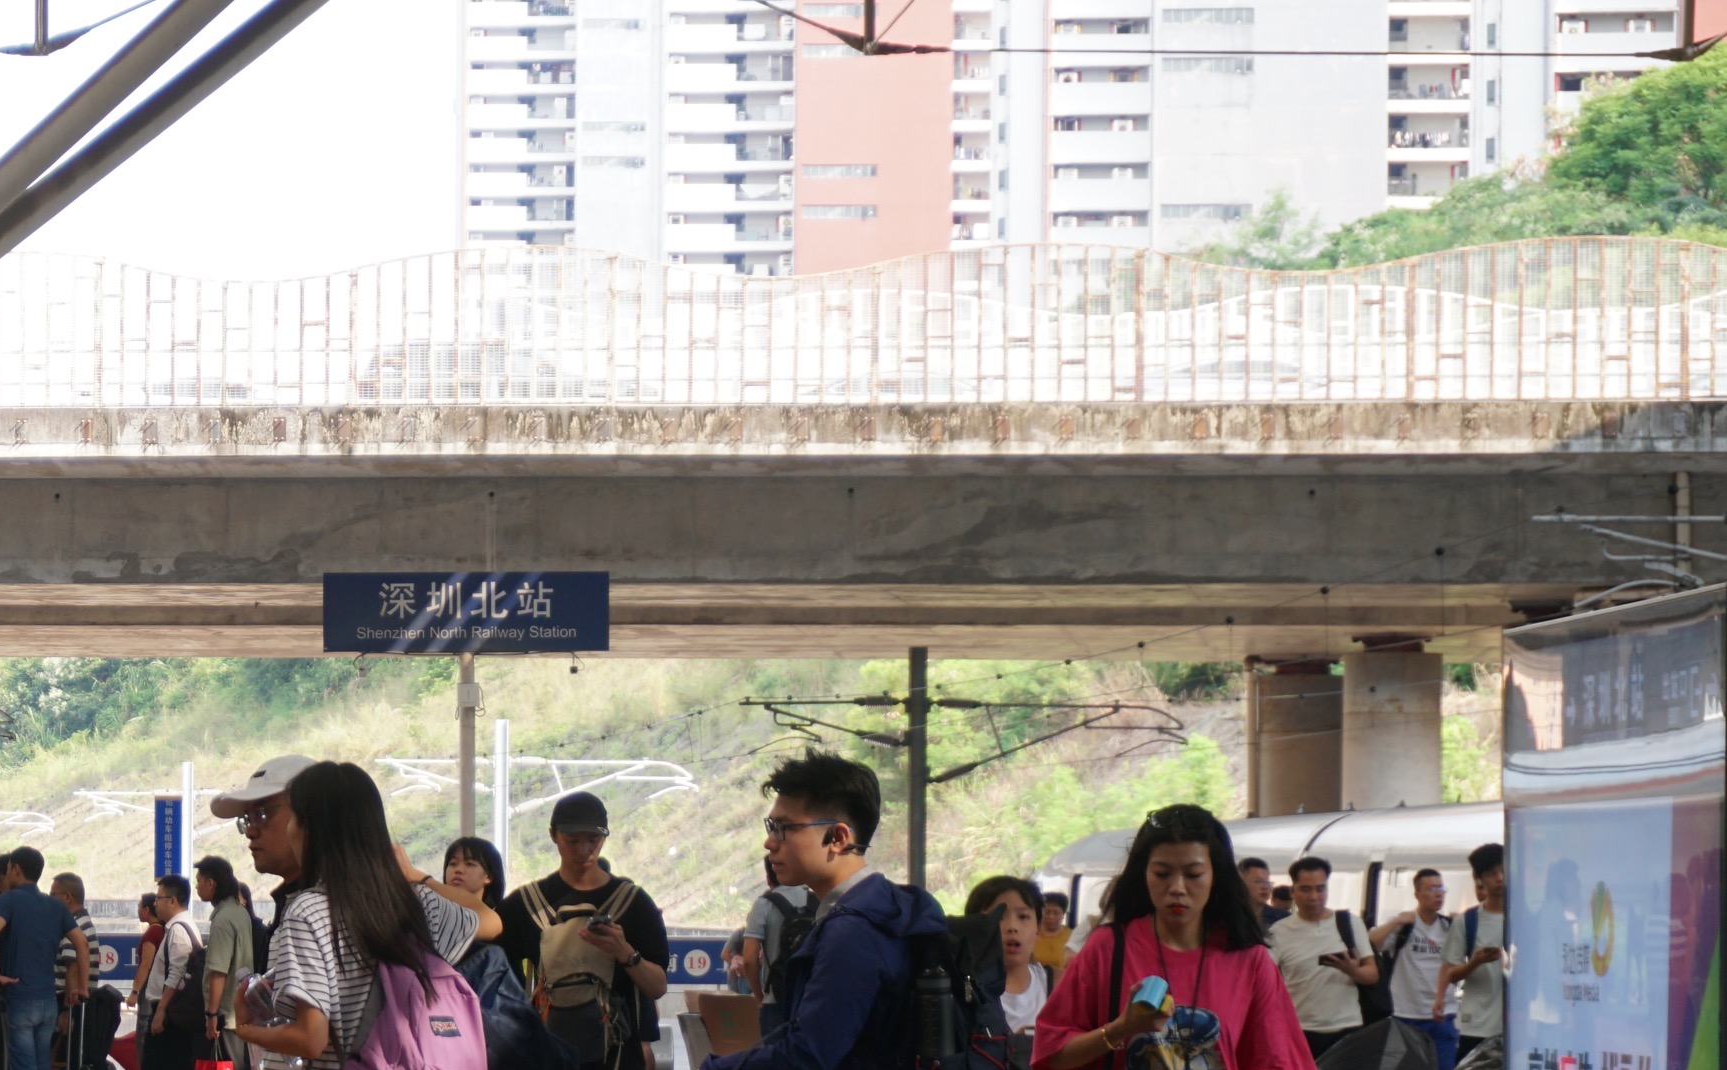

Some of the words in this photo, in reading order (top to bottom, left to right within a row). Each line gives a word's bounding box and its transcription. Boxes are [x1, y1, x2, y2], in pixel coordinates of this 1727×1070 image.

[379, 582, 553, 619] 深圳北站
[357, 627, 424, 639] Shenzhen
[430, 627, 466, 639] North
[472, 626, 524, 641] Railway
[529, 626, 576, 638] Station
[688, 955, 707, 969] 19
